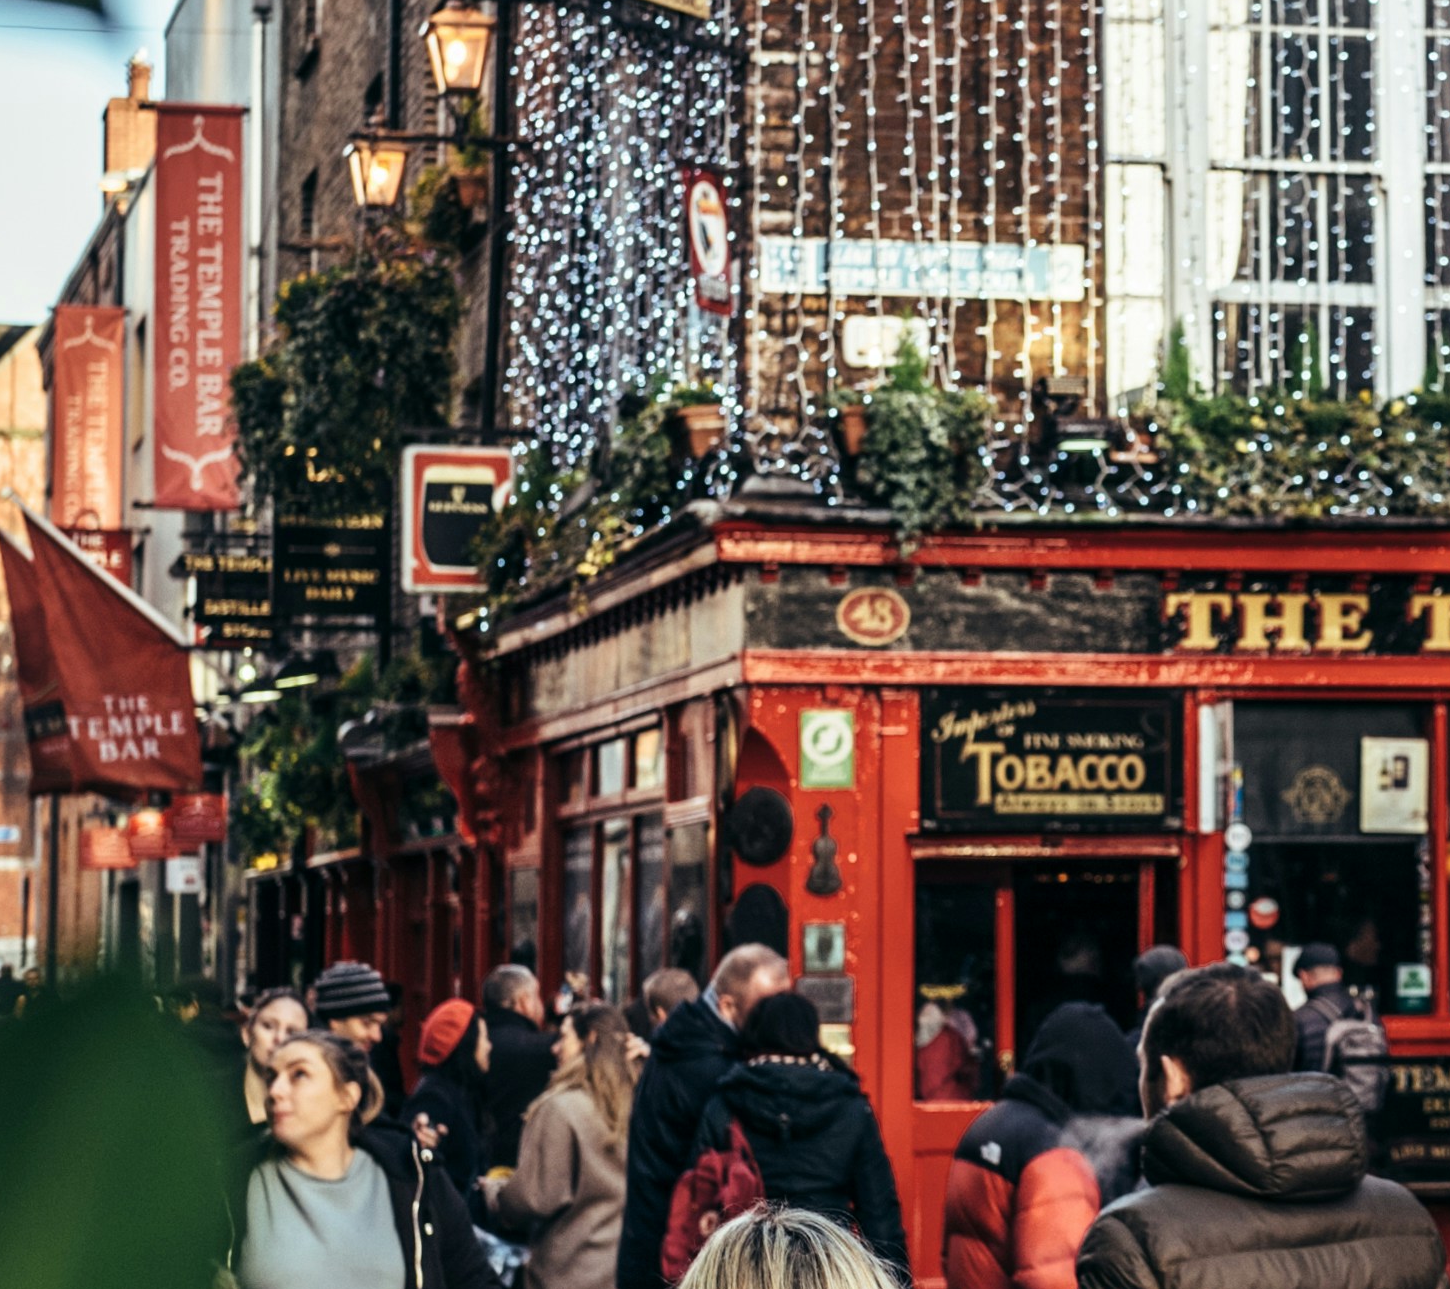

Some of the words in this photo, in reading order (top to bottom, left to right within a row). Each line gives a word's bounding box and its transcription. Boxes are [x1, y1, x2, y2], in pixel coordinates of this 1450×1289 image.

[194, 171, 224, 238] THE
[168, 217, 191, 335] TRADING
[194, 244, 225, 354] TEMPLE
[193, 358, 226, 438] BAR
[850, 595, 894, 632] 48
[1165, 591, 1375, 652] THE
[67, 707, 187, 742] TEMPLE
[101, 693, 151, 713] THE
[97, 732, 163, 764] BAR
[959, 741, 1147, 807] TOBACCO
